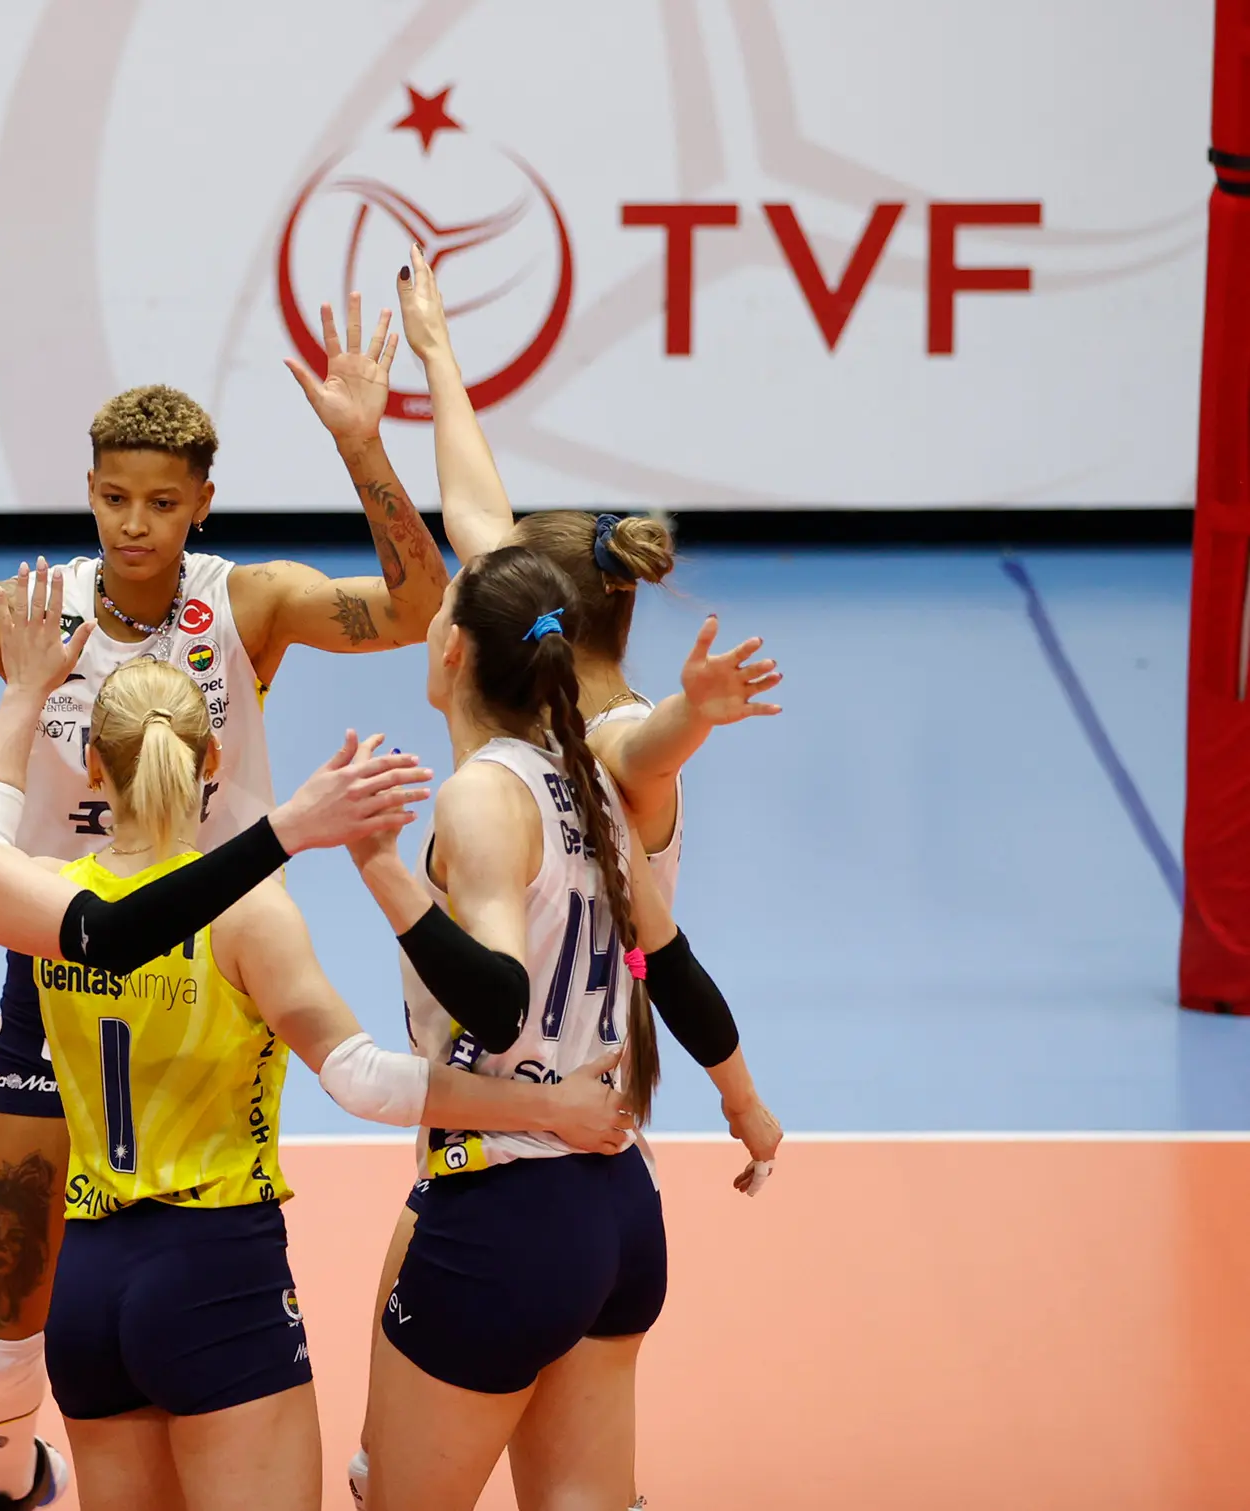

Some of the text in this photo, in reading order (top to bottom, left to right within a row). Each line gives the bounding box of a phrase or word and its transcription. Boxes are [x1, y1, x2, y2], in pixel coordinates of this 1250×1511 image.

[620, 203, 1042, 356] TVF
[59, 617, 73, 628] EV
[46, 704, 84, 713] ENTEGRE
[200, 678, 224, 693] pet
[542, 888, 621, 1045] 14
[98, 1017, 137, 1174] 1
